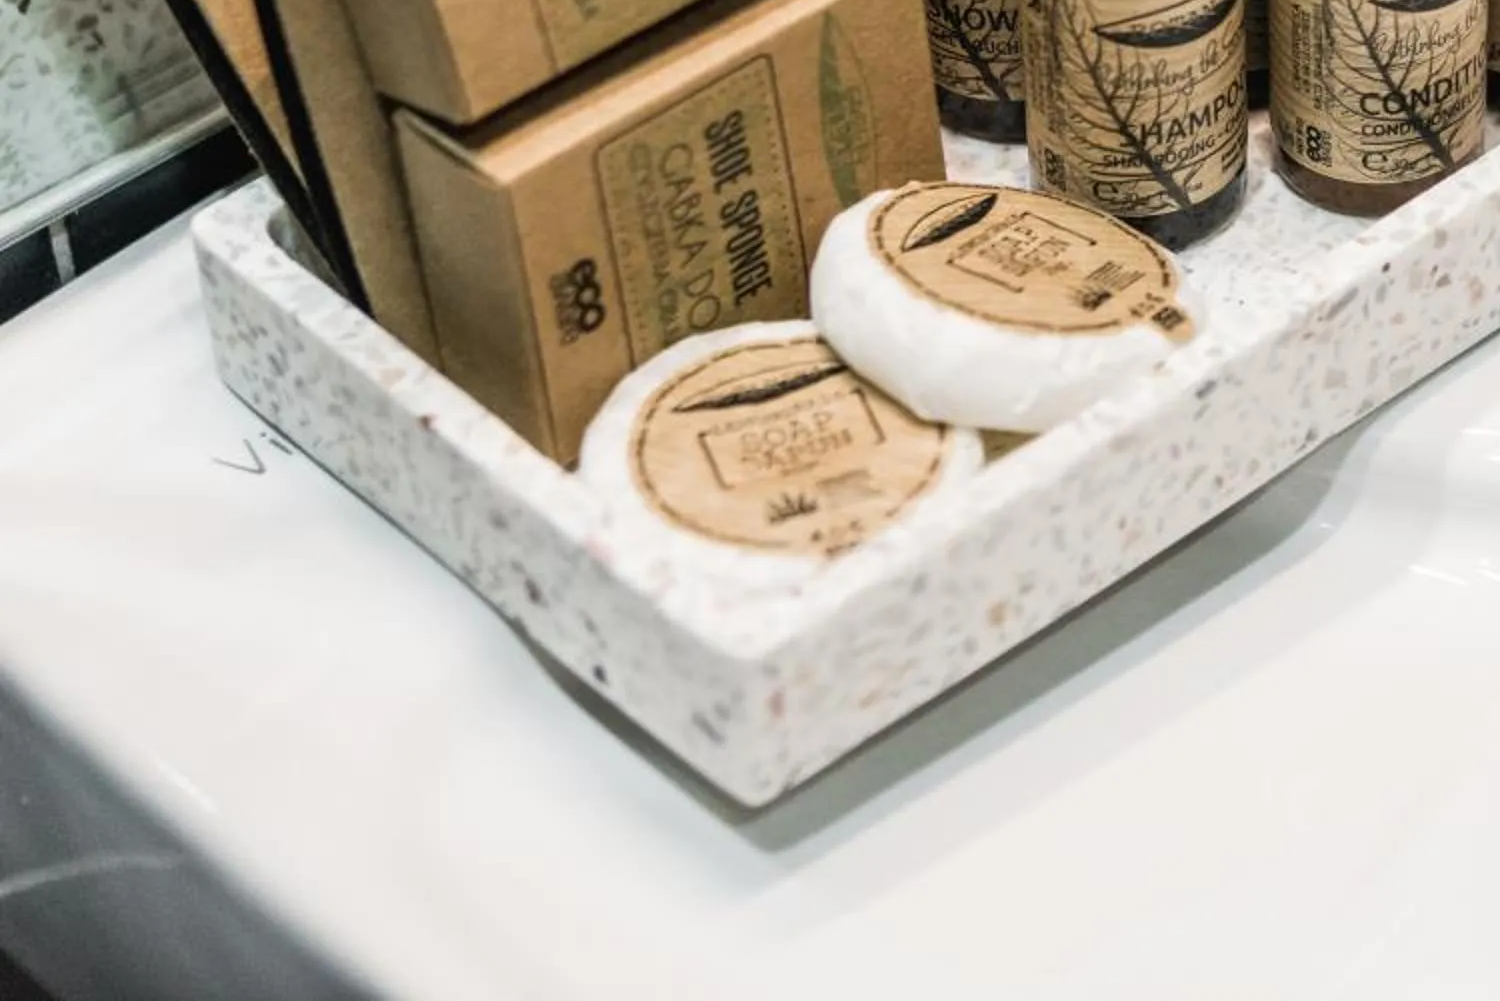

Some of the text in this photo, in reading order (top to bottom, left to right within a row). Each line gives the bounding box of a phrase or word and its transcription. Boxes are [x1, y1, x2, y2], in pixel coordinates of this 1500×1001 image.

[704, 109, 774, 308] SHOE SPONGE
[685, 270, 723, 331] DO
